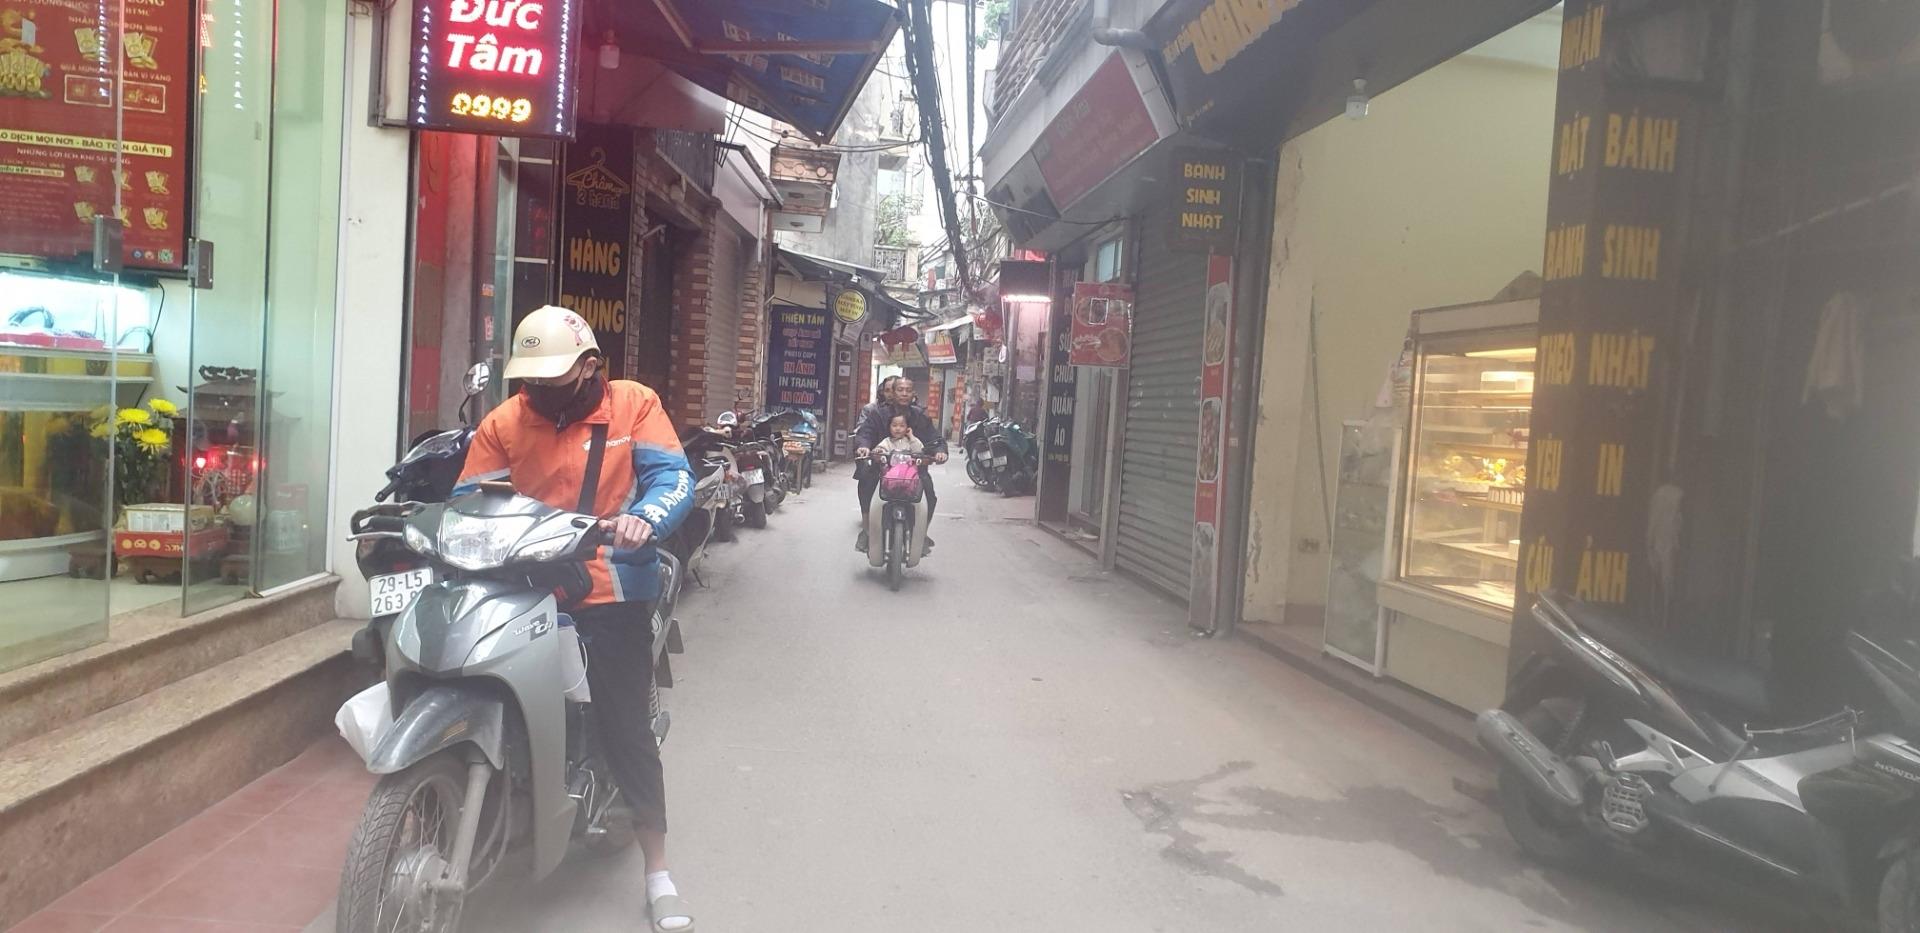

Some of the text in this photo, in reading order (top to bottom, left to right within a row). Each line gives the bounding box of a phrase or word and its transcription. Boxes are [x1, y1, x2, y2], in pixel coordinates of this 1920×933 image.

[447, 33, 542, 75] Tâm
[451, 92, 532, 122] 9999
[10, 133, 33, 142] DỊCH
[36, 134, 54, 145] MỌI
[56, 136, 74, 145] NƠI
[82, 138, 104, 149] BẢO
[106, 142, 129, 151] TON
[132, 143, 148, 153] GIÁ
[151, 146, 166, 156] TRỊ
[1603, 107, 1679, 173] BÁNH
[1186, 187, 1221, 205] SINH
[570, 228, 620, 277] HÀNG
[1544, 221, 1586, 281] BÁNH
[1601, 223, 1661, 281] SINH
[561, 288, 624, 333] THÙNG
[779, 376, 819, 389] IN TRANH
[1539, 331, 1576, 386] THEO
[1590, 328, 1655, 396] NHẬT
[1054, 424, 1066, 447] ÁO
[1536, 432, 1562, 492] YÊU
[1596, 443, 1624, 496] IN
[379, 571, 423, 595] 29-L5
[1576, 534, 1629, 603] ẢNH
